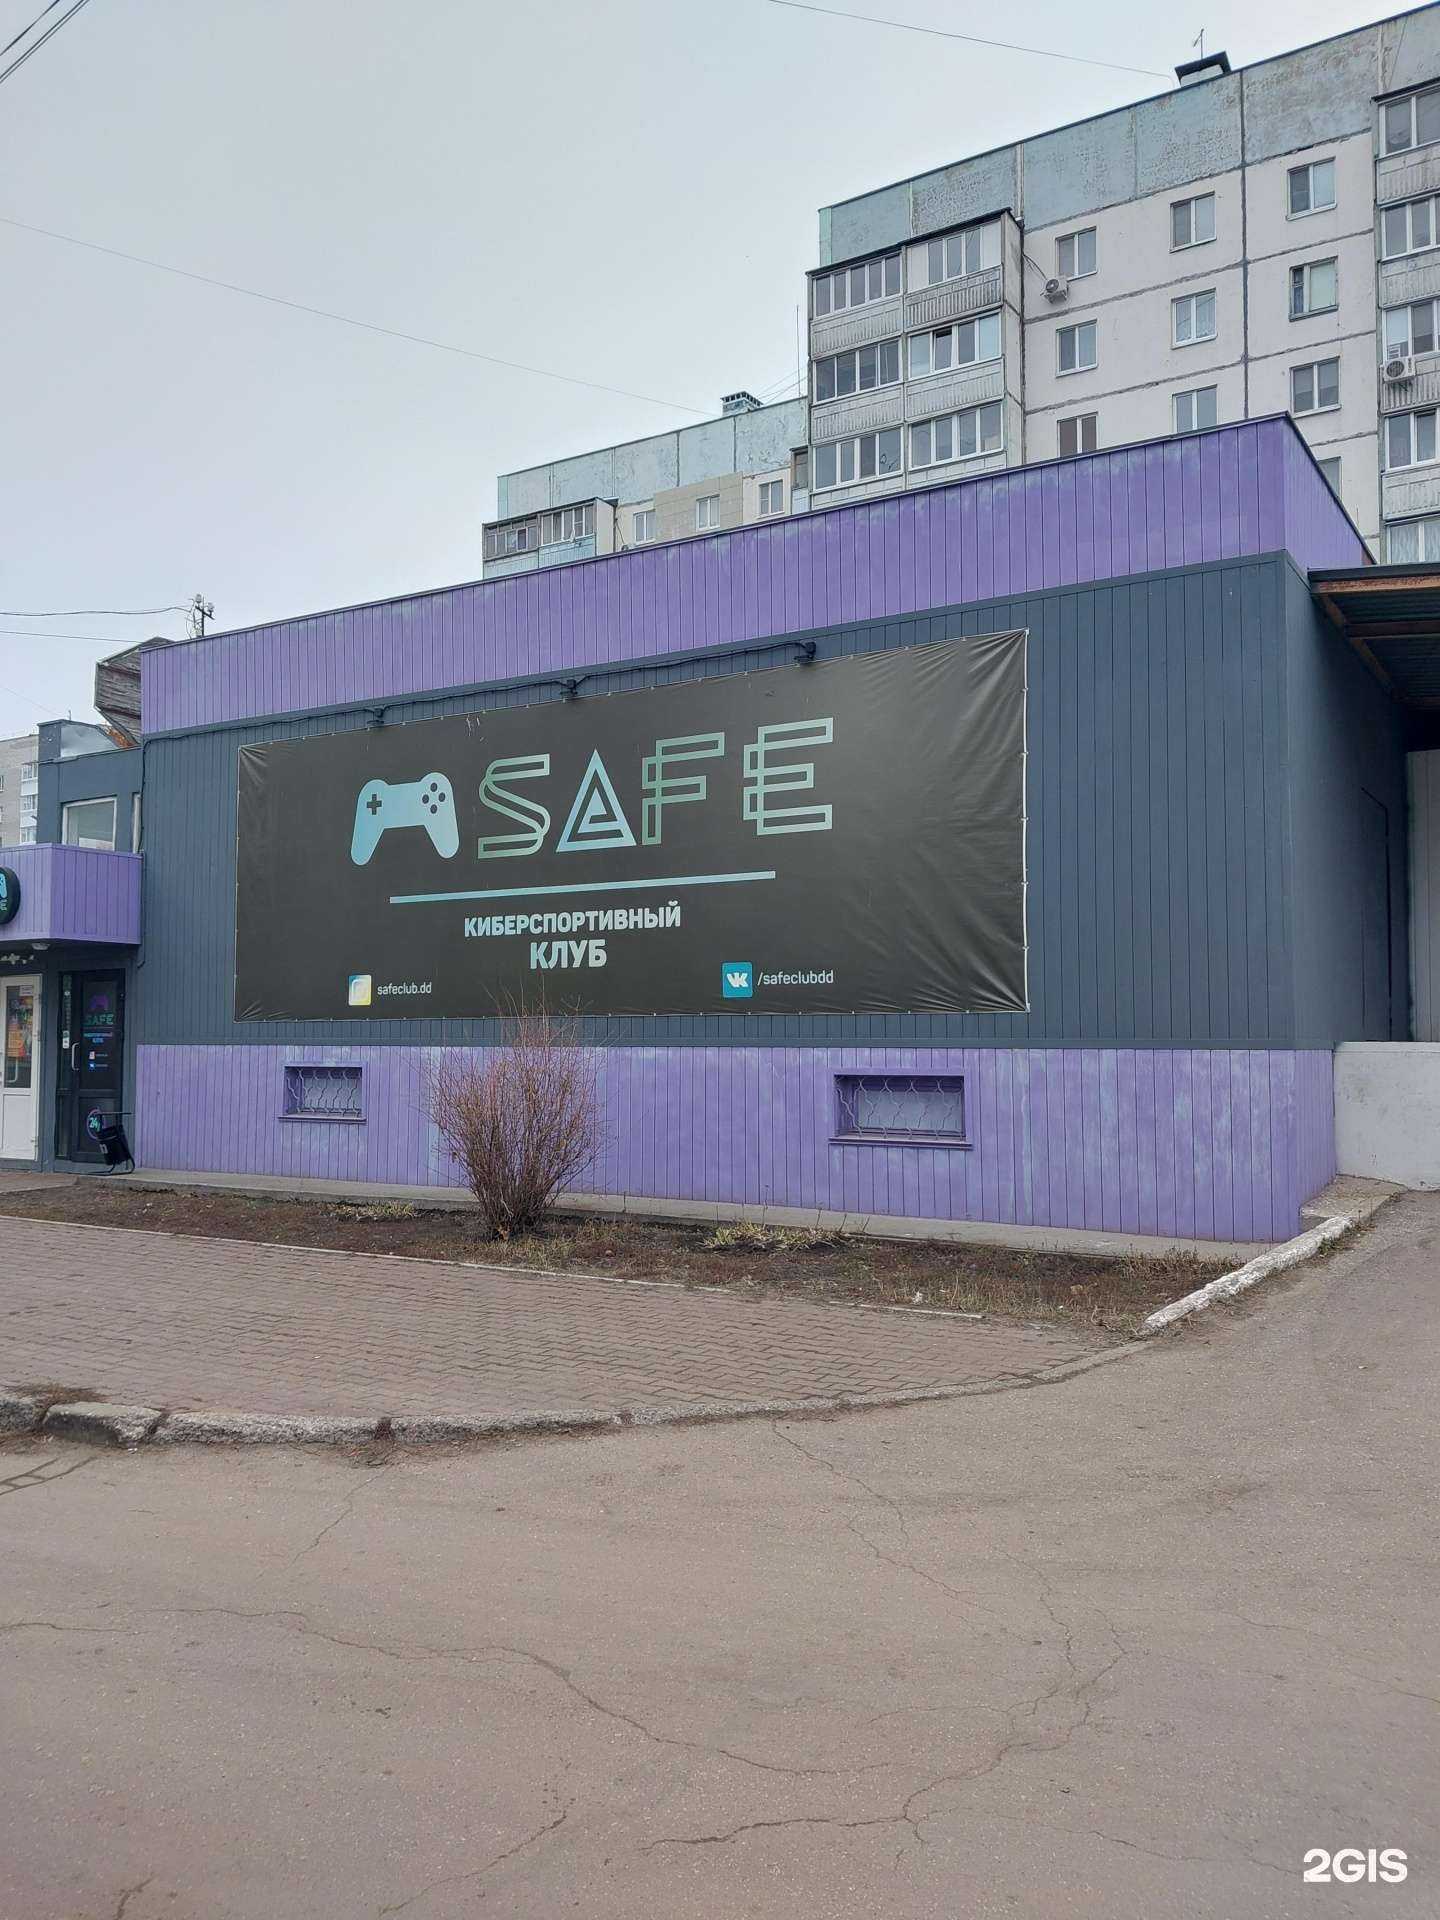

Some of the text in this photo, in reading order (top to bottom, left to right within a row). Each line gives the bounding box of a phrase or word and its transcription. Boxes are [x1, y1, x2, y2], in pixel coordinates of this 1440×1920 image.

[478, 717, 834, 859] SAFE
[464, 900, 681, 937] КИБЕРСПОРТИВНЫЙ
[530, 939, 608, 969] КЛУБ
[377, 982, 432, 995] safeclub.dd
[757, 970, 834, 986] /safeclubdd
